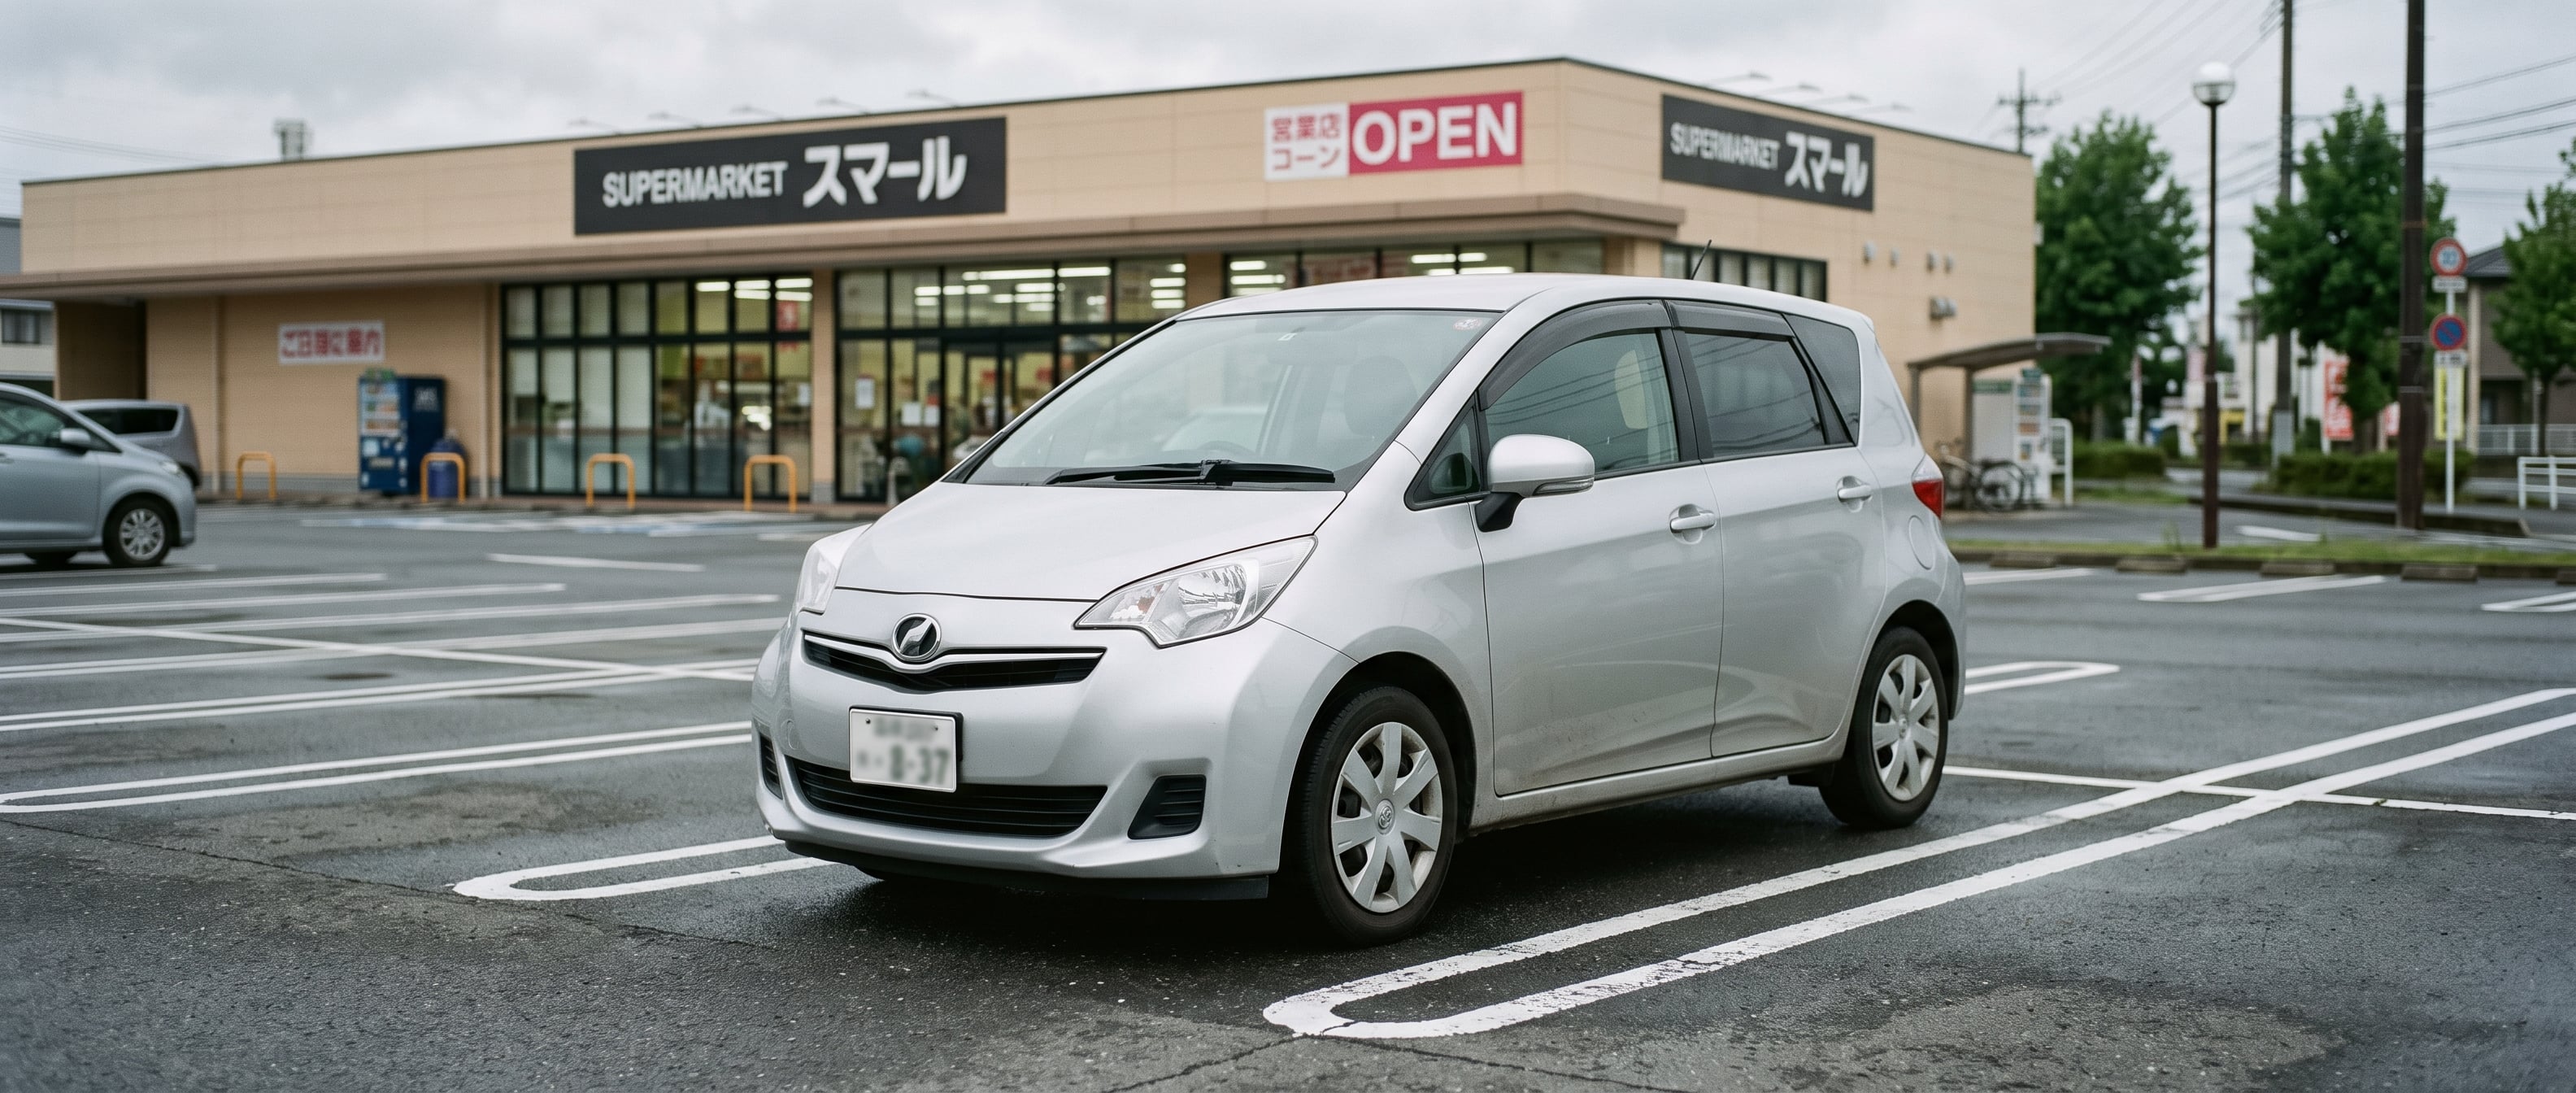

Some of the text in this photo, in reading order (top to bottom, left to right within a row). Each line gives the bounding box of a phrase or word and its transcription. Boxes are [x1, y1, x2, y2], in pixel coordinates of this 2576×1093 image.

[1351, 101, 1517, 165] OPEN
[1669, 122, 1869, 198] SUPERMARKET スマール
[603, 135, 968, 208] SUPERMARKET スマール
